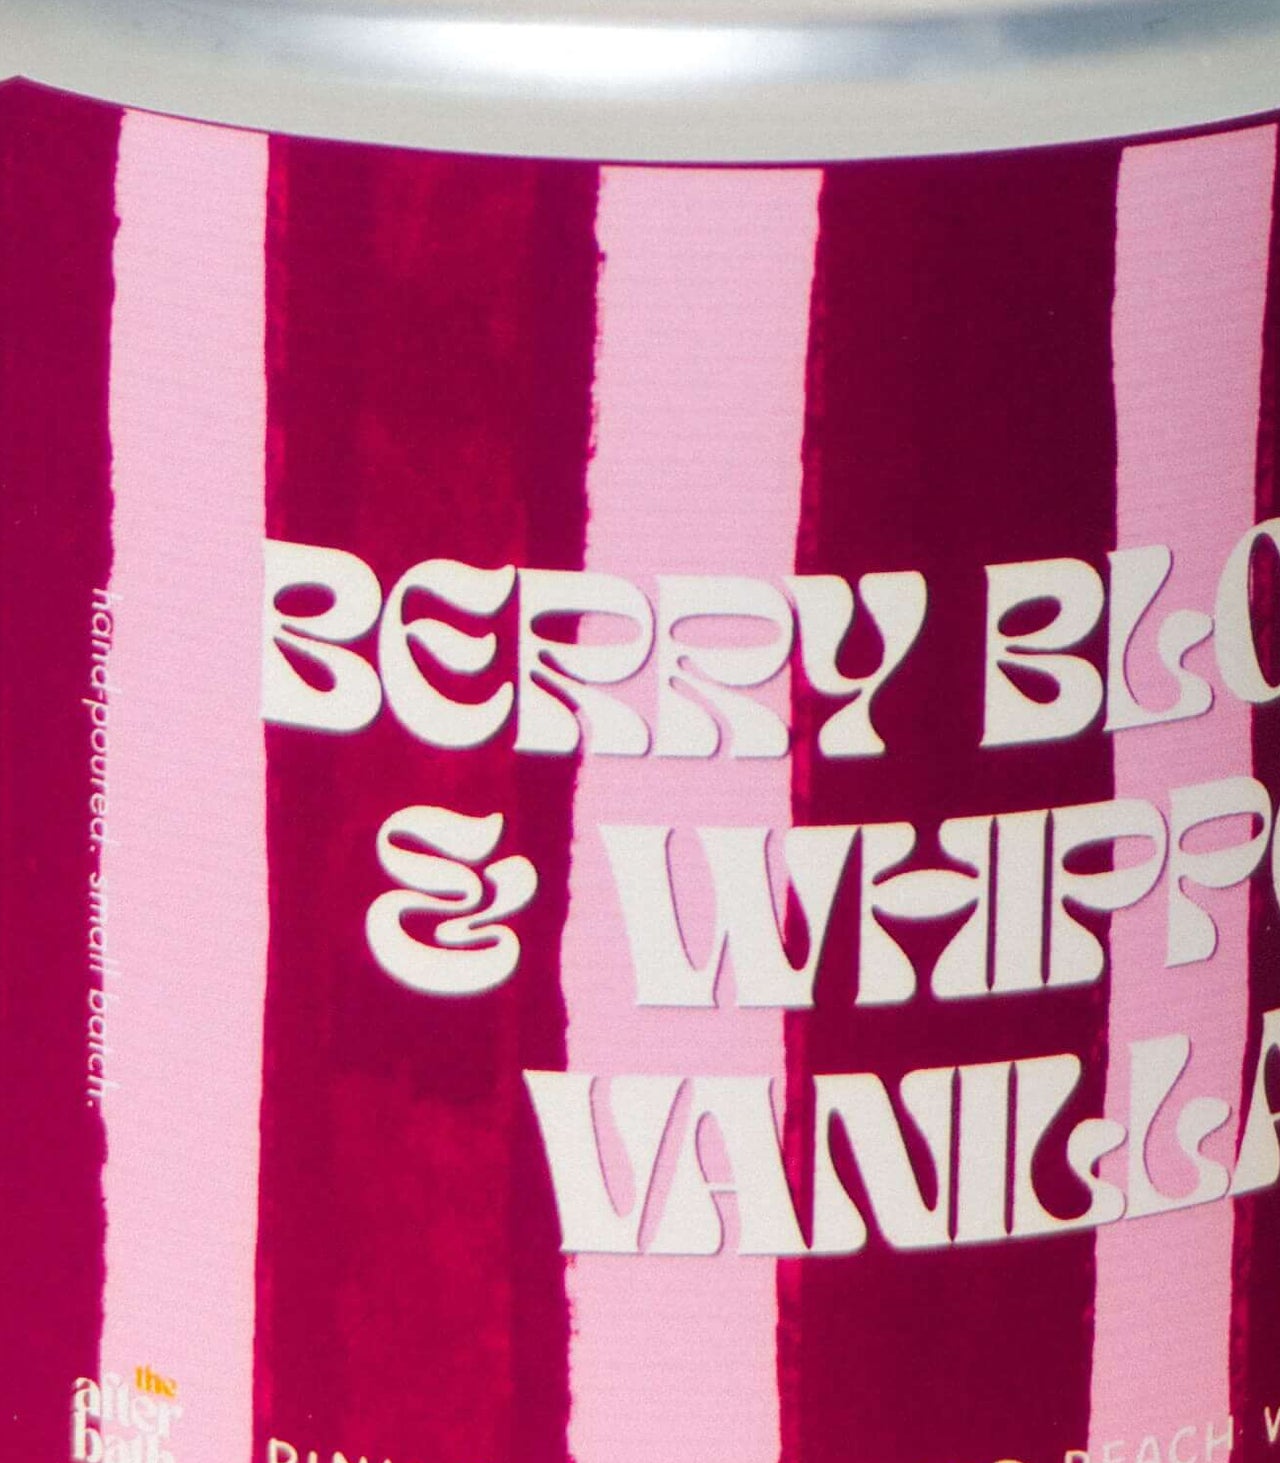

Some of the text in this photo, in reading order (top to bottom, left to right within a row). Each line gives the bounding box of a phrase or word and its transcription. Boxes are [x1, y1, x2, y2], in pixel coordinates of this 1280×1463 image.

[261, 537, 928, 758] BERRY
[80, 587, 122, 1109] hand-poured. small batch.
[364, 804, 539, 996] &
[73, 1372, 183, 1436] after
[134, 1364, 177, 1398] the
